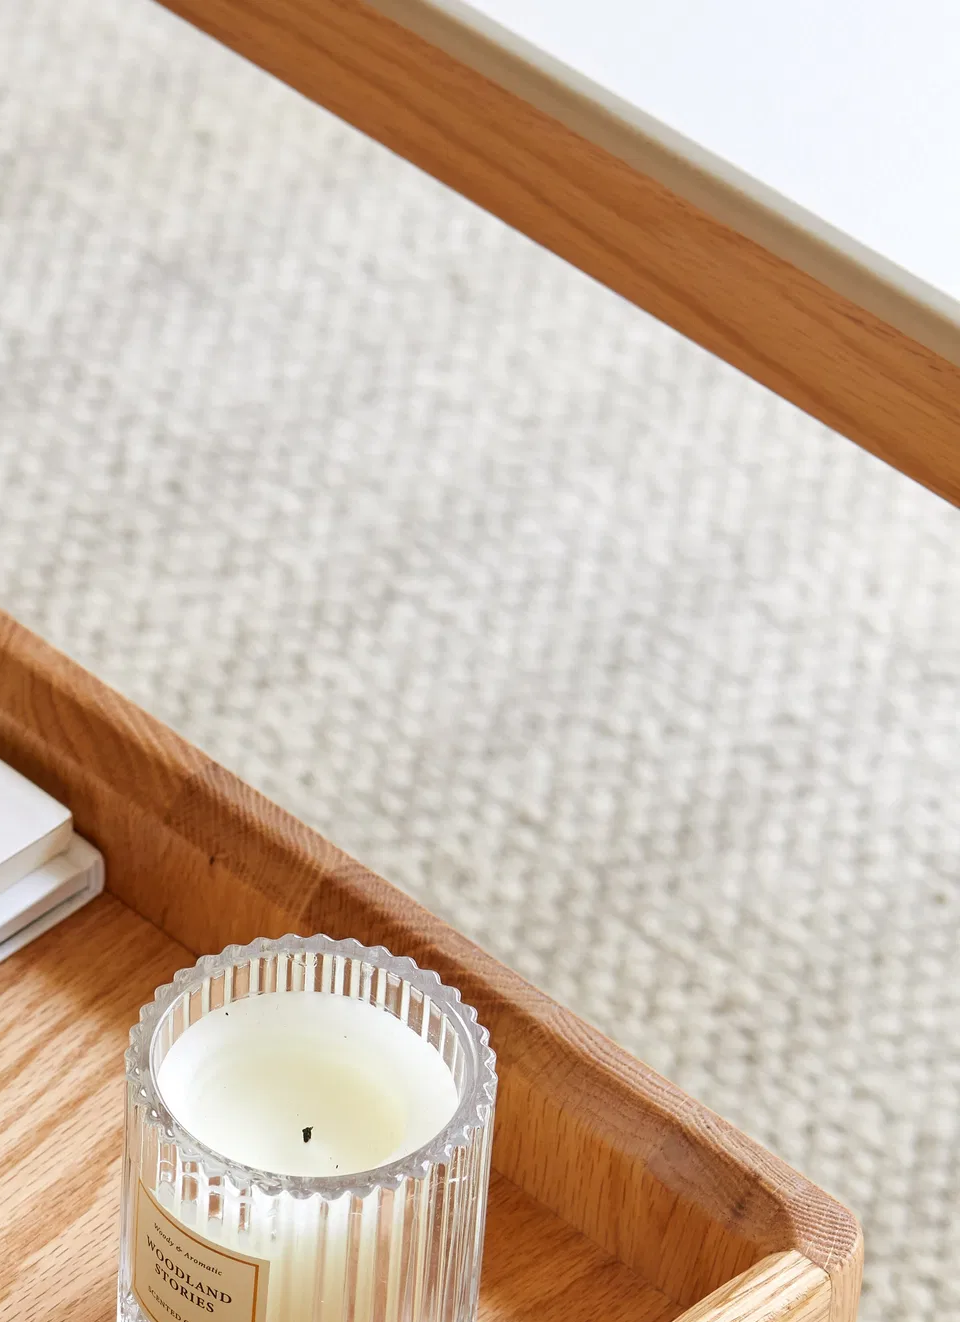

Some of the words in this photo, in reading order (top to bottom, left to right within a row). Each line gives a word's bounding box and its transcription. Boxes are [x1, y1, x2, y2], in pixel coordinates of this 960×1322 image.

[146, 1234, 232, 1305] WOODLAND
[153, 1222, 175, 1248] Woody
[175, 1245, 183, 1253] &
[183, 1251, 223, 1276] Aromatic
[147, 1285, 182, 1322] SCENTED
[154, 1263, 215, 1313] STORIES
